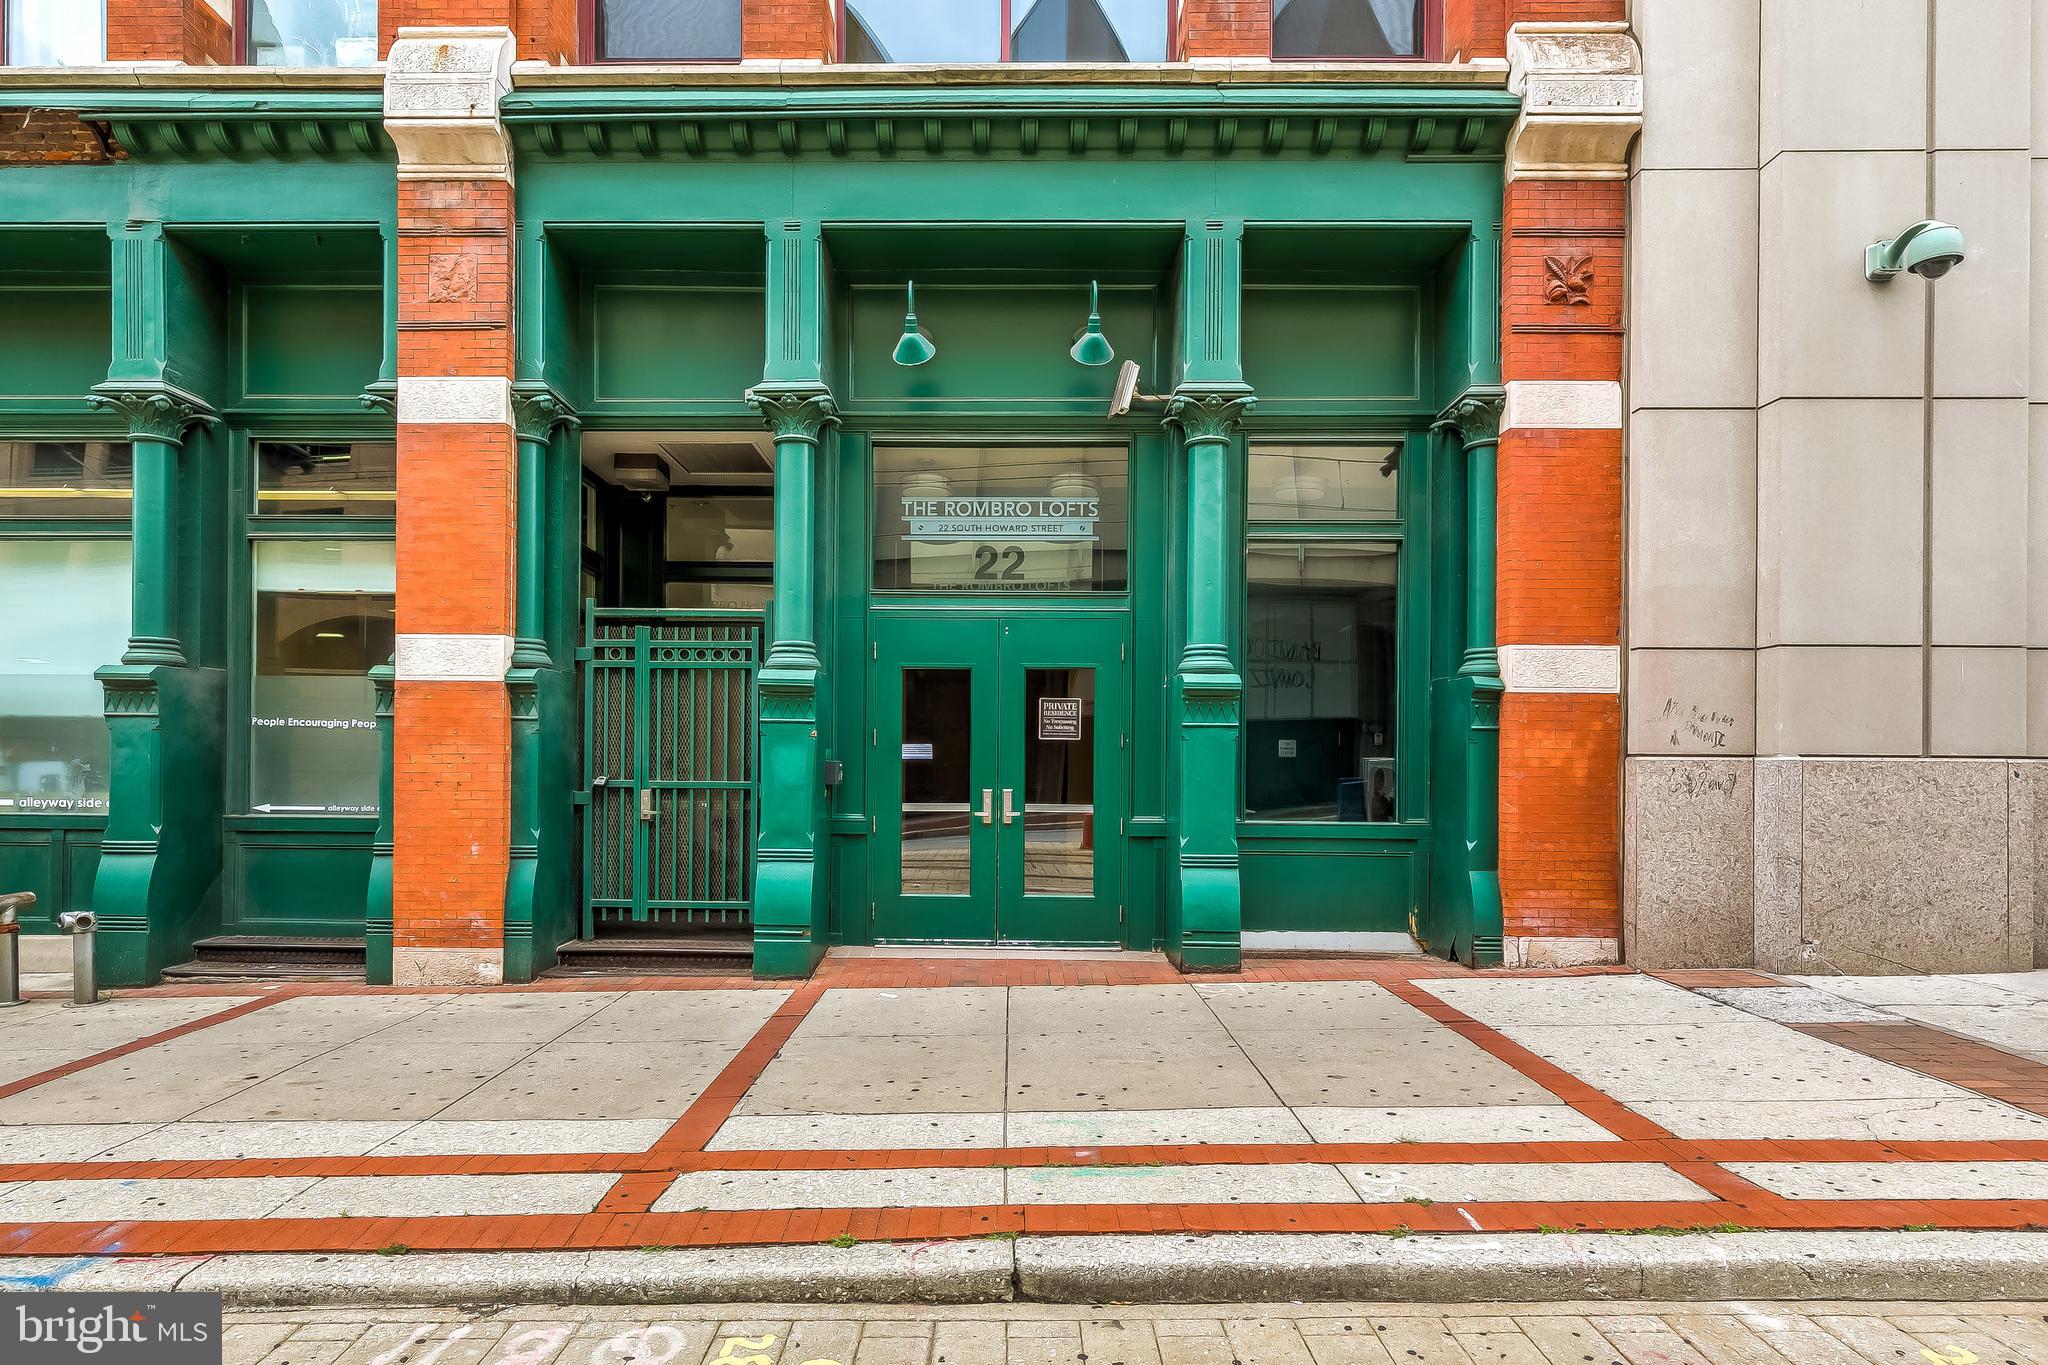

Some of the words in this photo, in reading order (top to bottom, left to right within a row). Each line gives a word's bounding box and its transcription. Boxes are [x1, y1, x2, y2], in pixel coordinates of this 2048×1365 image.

[902, 501, 938, 516] THE
[944, 501, 1032, 517] ROMBRO
[1039, 501, 1099, 517] LOFTS
[938, 524, 949, 532] 22
[951, 524, 982, 532] SOUTH
[985, 524, 1028, 533] HOWARD
[1031, 524, 1063, 532] STREET
[974, 545, 1025, 580] 22
[251, 717, 286, 728] People
[287, 718, 349, 729] Encouraging
[19, 797, 74, 810] alleyway
[77, 797, 103, 808] side
[327, 804, 360, 813] alleyway
[360, 804, 376, 812] side
